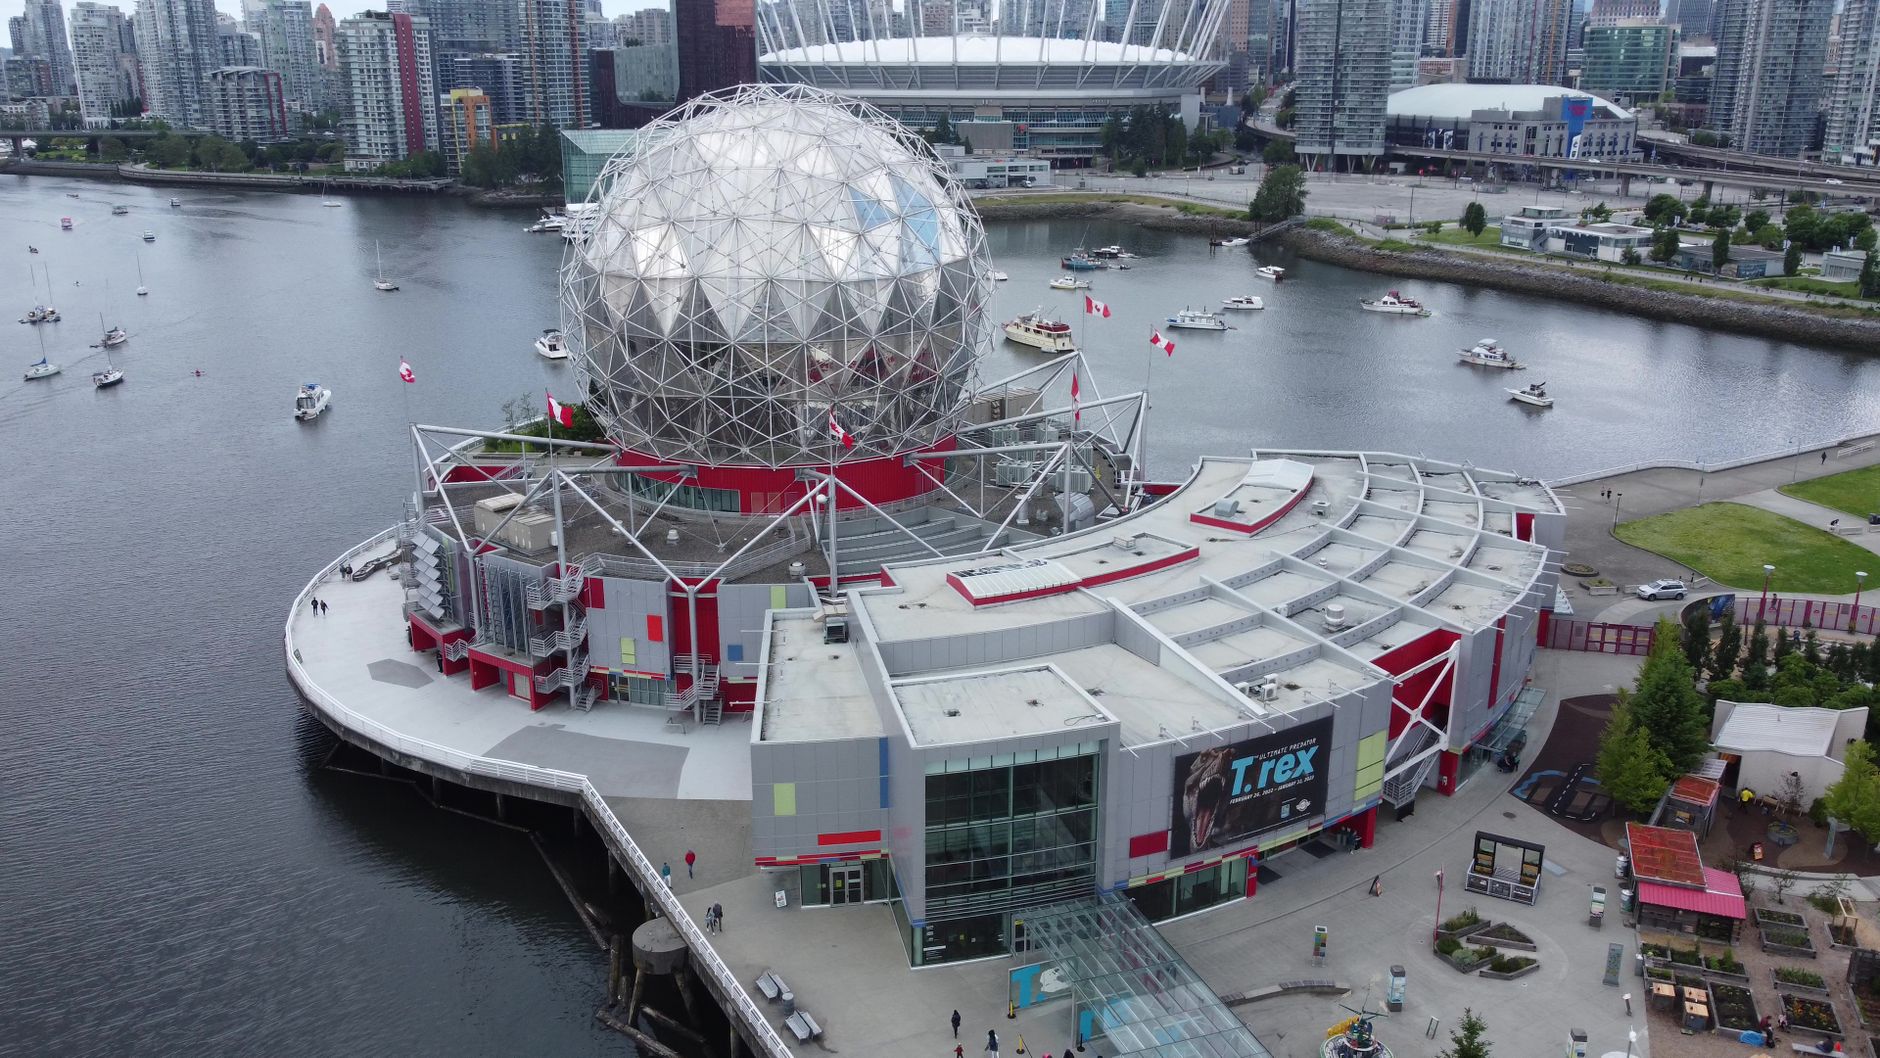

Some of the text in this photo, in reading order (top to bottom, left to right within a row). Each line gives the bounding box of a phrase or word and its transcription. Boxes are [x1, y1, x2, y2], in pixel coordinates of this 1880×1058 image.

[1259, 738, 1317, 760] ULTIMATE PREDATOR
[1229, 794, 1253, 804] FEBRUARY
[1277, 780, 1296, 791] JANUARY
